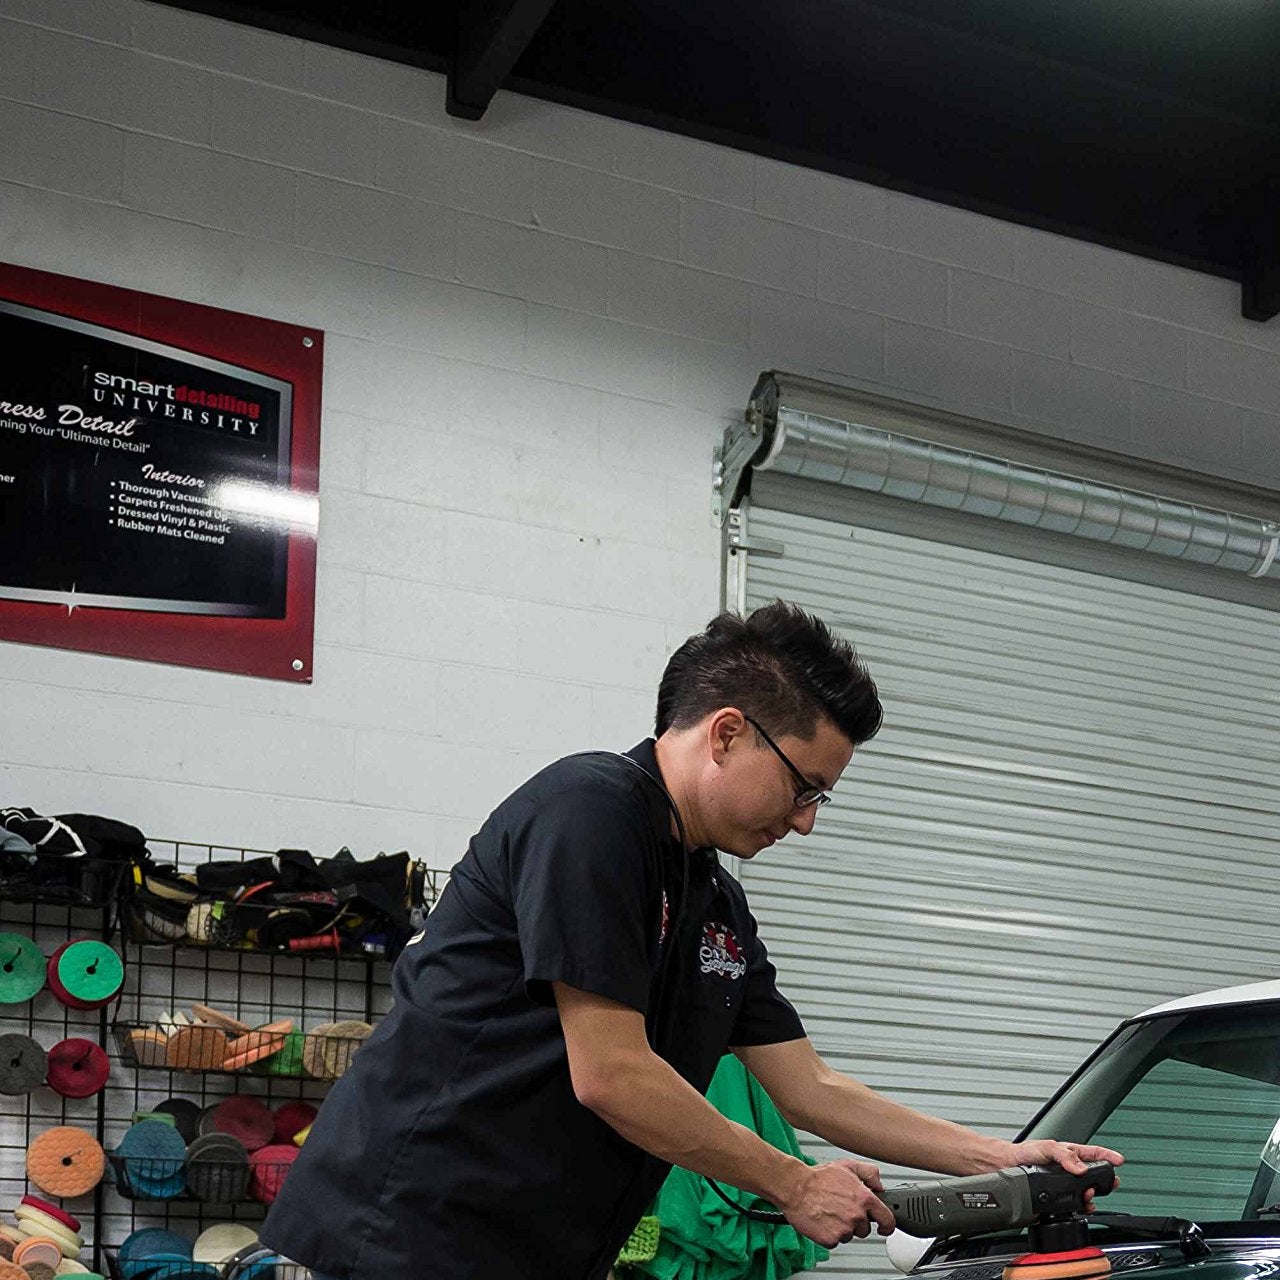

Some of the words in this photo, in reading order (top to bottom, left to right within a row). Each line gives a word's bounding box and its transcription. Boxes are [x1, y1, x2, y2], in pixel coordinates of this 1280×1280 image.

[94, 372, 261, 419] smartdetailing
[58, 404, 138, 436] Detail
[93, 388, 259, 435] UNIVERSITY
[29, 422, 55, 436] Your
[119, 481, 169, 498] Thorough
[141, 464, 206, 488] Interior
[118, 493, 158, 508] Carpets
[159, 501, 212, 518] Freshened
[117, 518, 155, 533] Rubber
[157, 525, 182, 538] Mats
[183, 529, 225, 545] Cleaned
[118, 506, 159, 521] Dressed
[160, 513, 187, 527] Vinyl
[188, 517, 197, 527] &
[198, 519, 231, 534] Plastic
